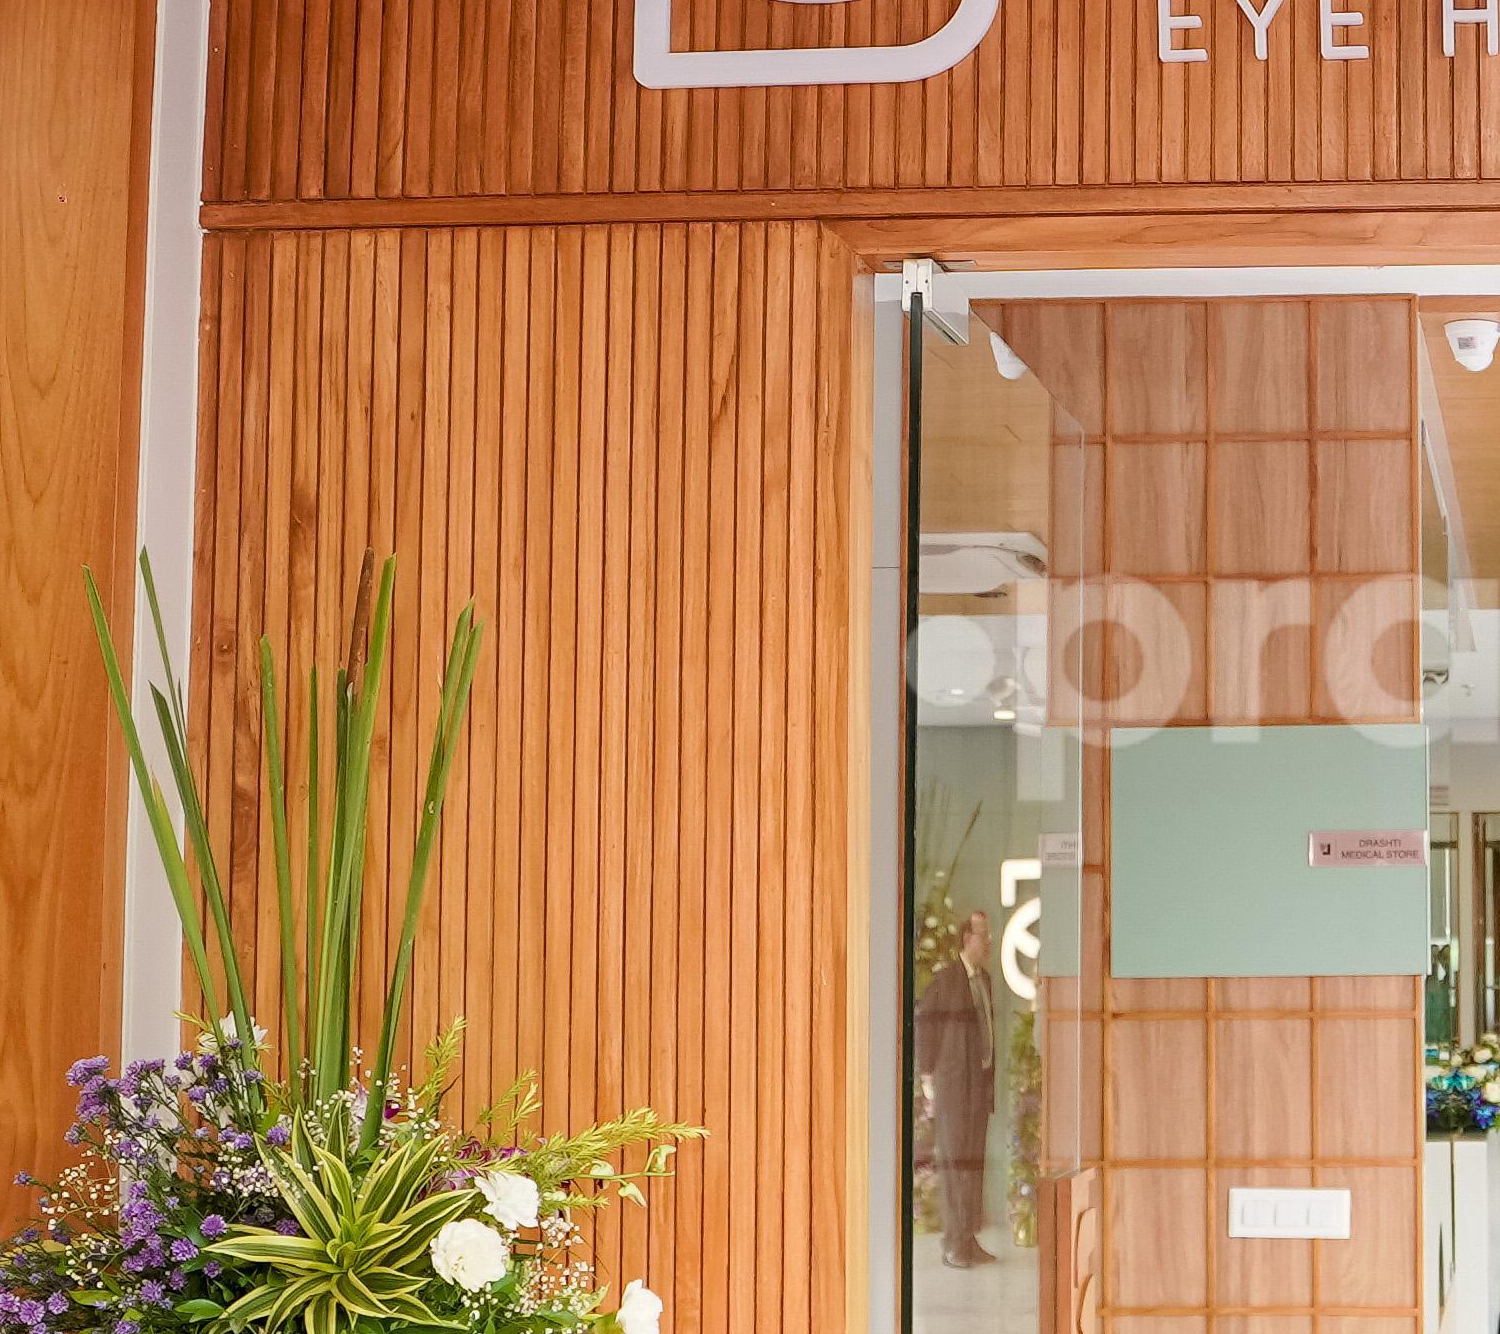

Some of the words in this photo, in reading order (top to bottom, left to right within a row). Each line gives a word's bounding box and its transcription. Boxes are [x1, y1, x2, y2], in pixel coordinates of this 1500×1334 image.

[1358, 839, 1402, 848] DRASHTI
[1341, 850, 1383, 859] MEDICAL
[1386, 850, 1419, 859] STORE
